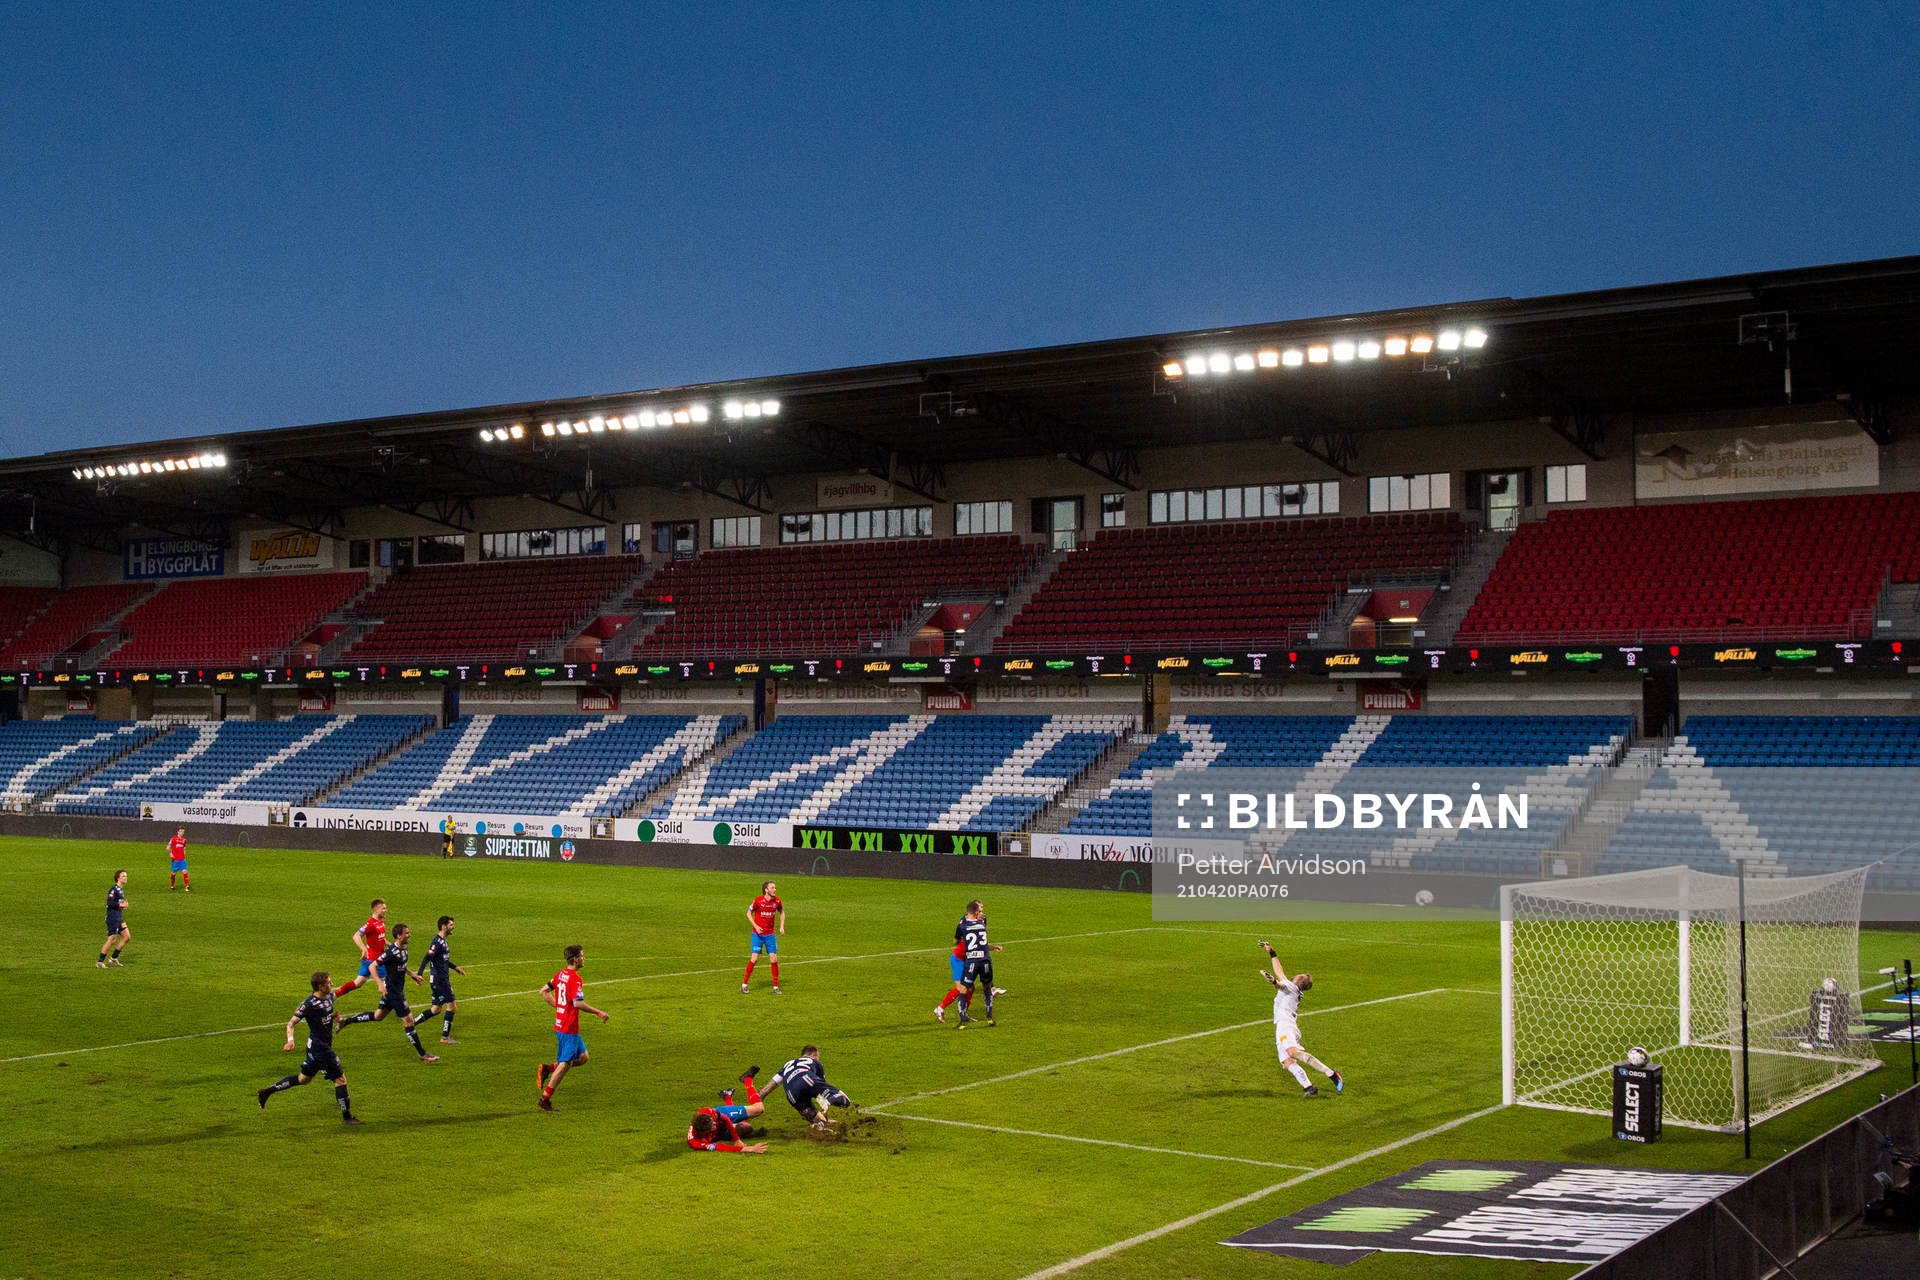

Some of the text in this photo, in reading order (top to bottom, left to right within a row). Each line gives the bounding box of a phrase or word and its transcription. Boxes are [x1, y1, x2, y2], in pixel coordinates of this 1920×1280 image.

[1727, 464, 1821, 480] Helsingborg
[1824, 461, 1849, 473] AB
[823, 482, 877, 498] #jagvillhbg
[249, 532, 321, 566] WALLIN
[1326, 655, 1360, 667] WALLIN
[1511, 652, 1548, 664] WALLIN
[1714, 649, 1757, 662] WALLIN
[864, 662, 890, 672] WALLIN
[1005, 659, 1033, 671] WALLIN
[1158, 657, 1189, 668] WALLIN
[300, 699, 322, 711] PUMA
[582, 698, 609, 709] PUMA
[927, 697, 960, 709] PUMA
[1364, 695, 1405, 708] PUMA
[182, 806, 237, 819] vasatorp.golf
[487, 821, 506, 829] Resurs
[525, 823, 544, 831] Resurs
[563, 824, 583, 832] Resurs
[657, 821, 683, 834] Solid
[734, 824, 761, 837] Solid
[485, 838, 551, 859] SUPERETTAN
[965, 931, 988, 951] 23
[557, 981, 567, 1007] 13
[783, 1057, 814, 1076] 22
[1628, 1070, 1647, 1078] OBOS
[1624, 1081, 1640, 1133] SELECT
[1627, 1134, 1645, 1143] OBOS
